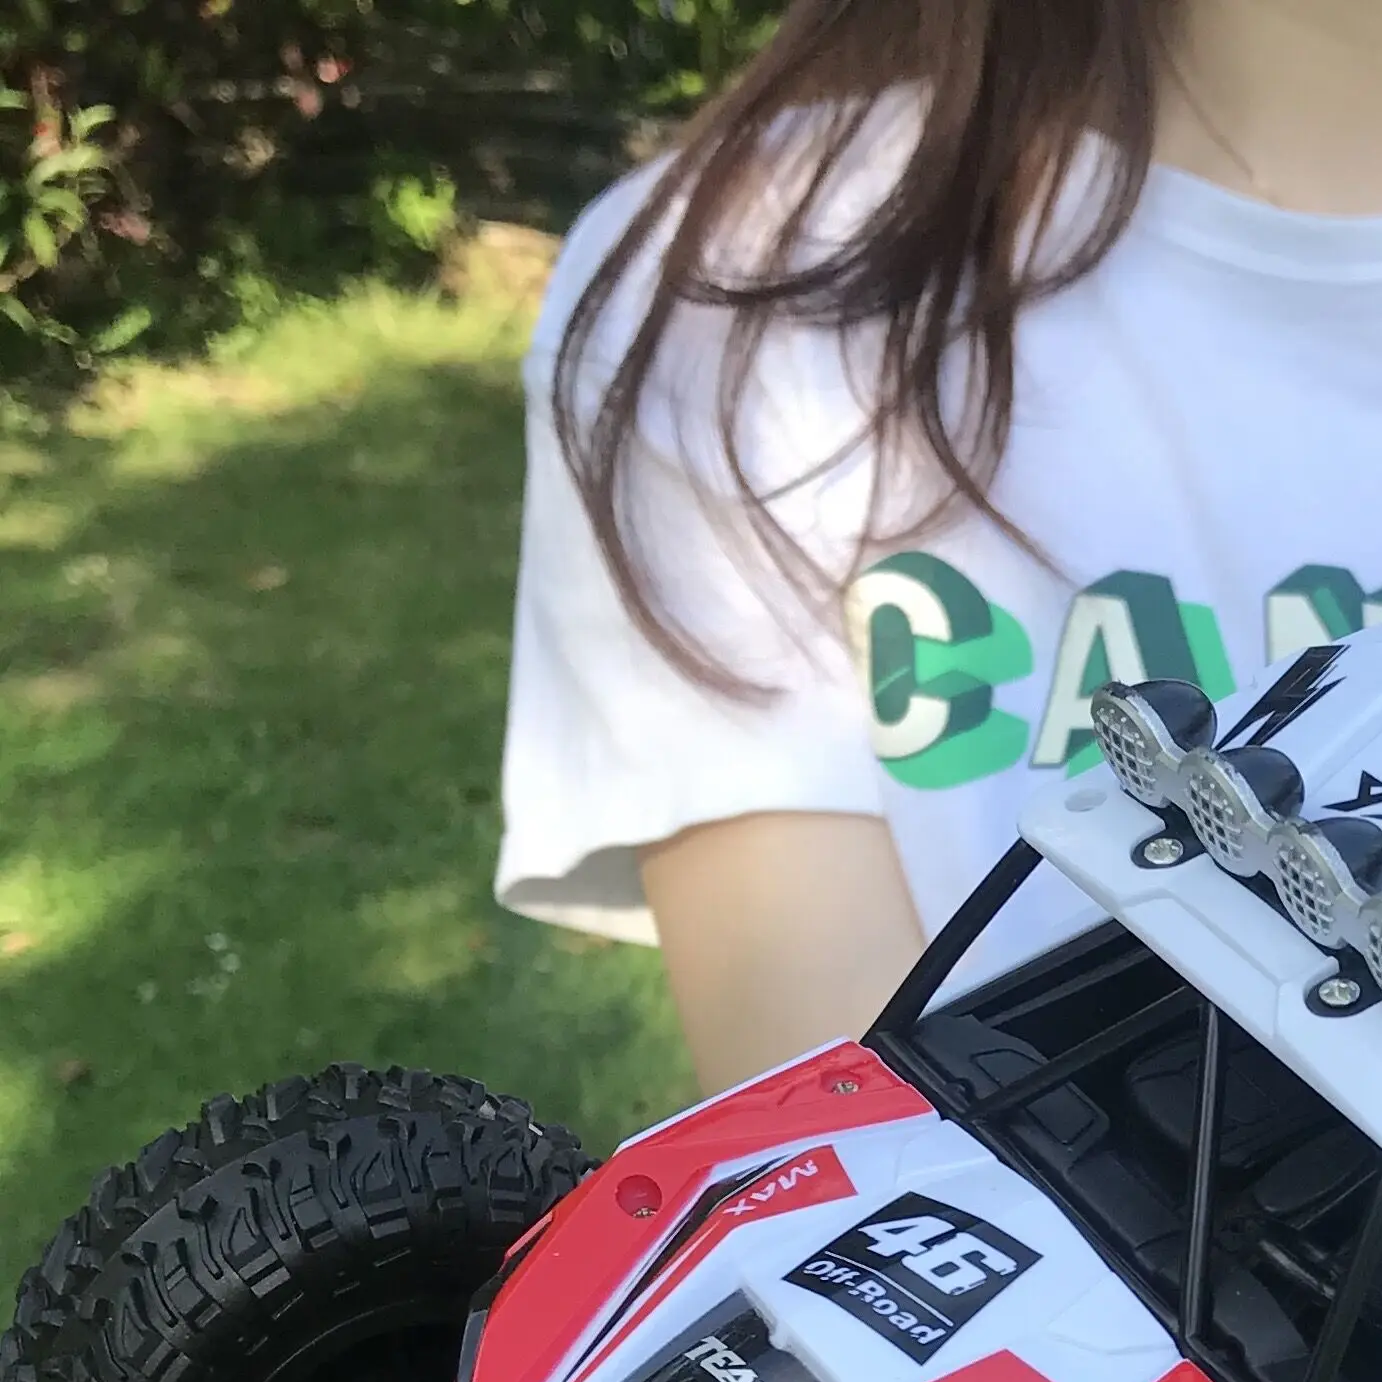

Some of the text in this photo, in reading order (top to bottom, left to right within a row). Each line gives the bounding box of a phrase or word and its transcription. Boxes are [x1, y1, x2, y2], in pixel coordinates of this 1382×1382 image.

[721, 1158, 819, 1217] MAX
[857, 1214, 1018, 1297] 46
[802, 1259, 948, 1346] Off-Road
